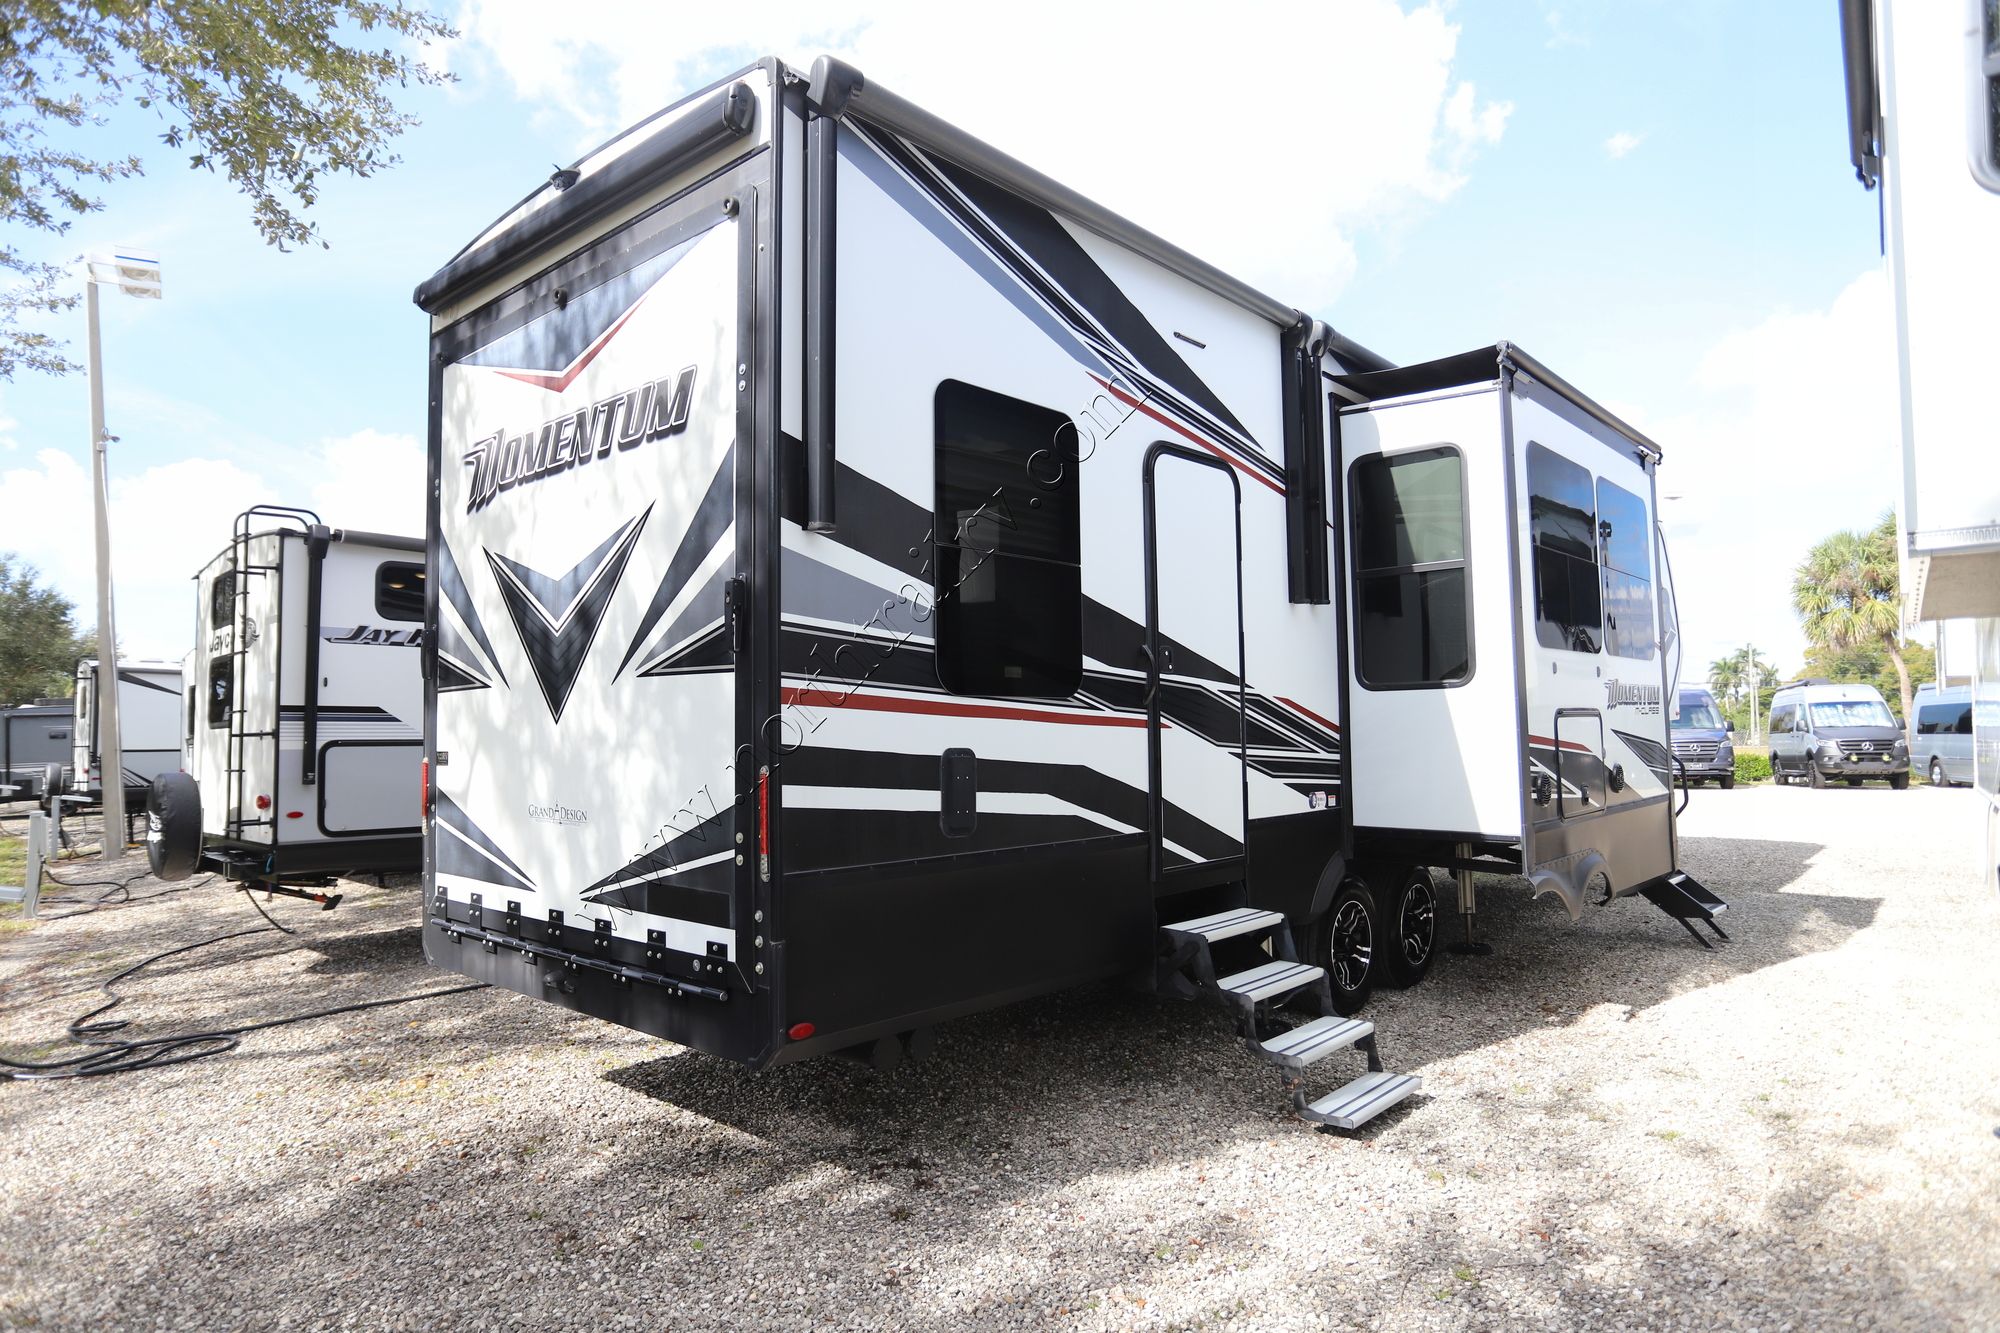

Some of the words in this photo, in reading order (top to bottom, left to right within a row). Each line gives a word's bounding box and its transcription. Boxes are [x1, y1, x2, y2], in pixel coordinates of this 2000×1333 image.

[462, 364, 697, 516] MOMENTUM
[208, 632, 234, 655] Jayc
[331, 625, 404, 646] JAY
[1604, 678, 1660, 710] MOMENTUM
[528, 803, 554, 819] GRAND
[560, 806, 588, 821] DESIGN
